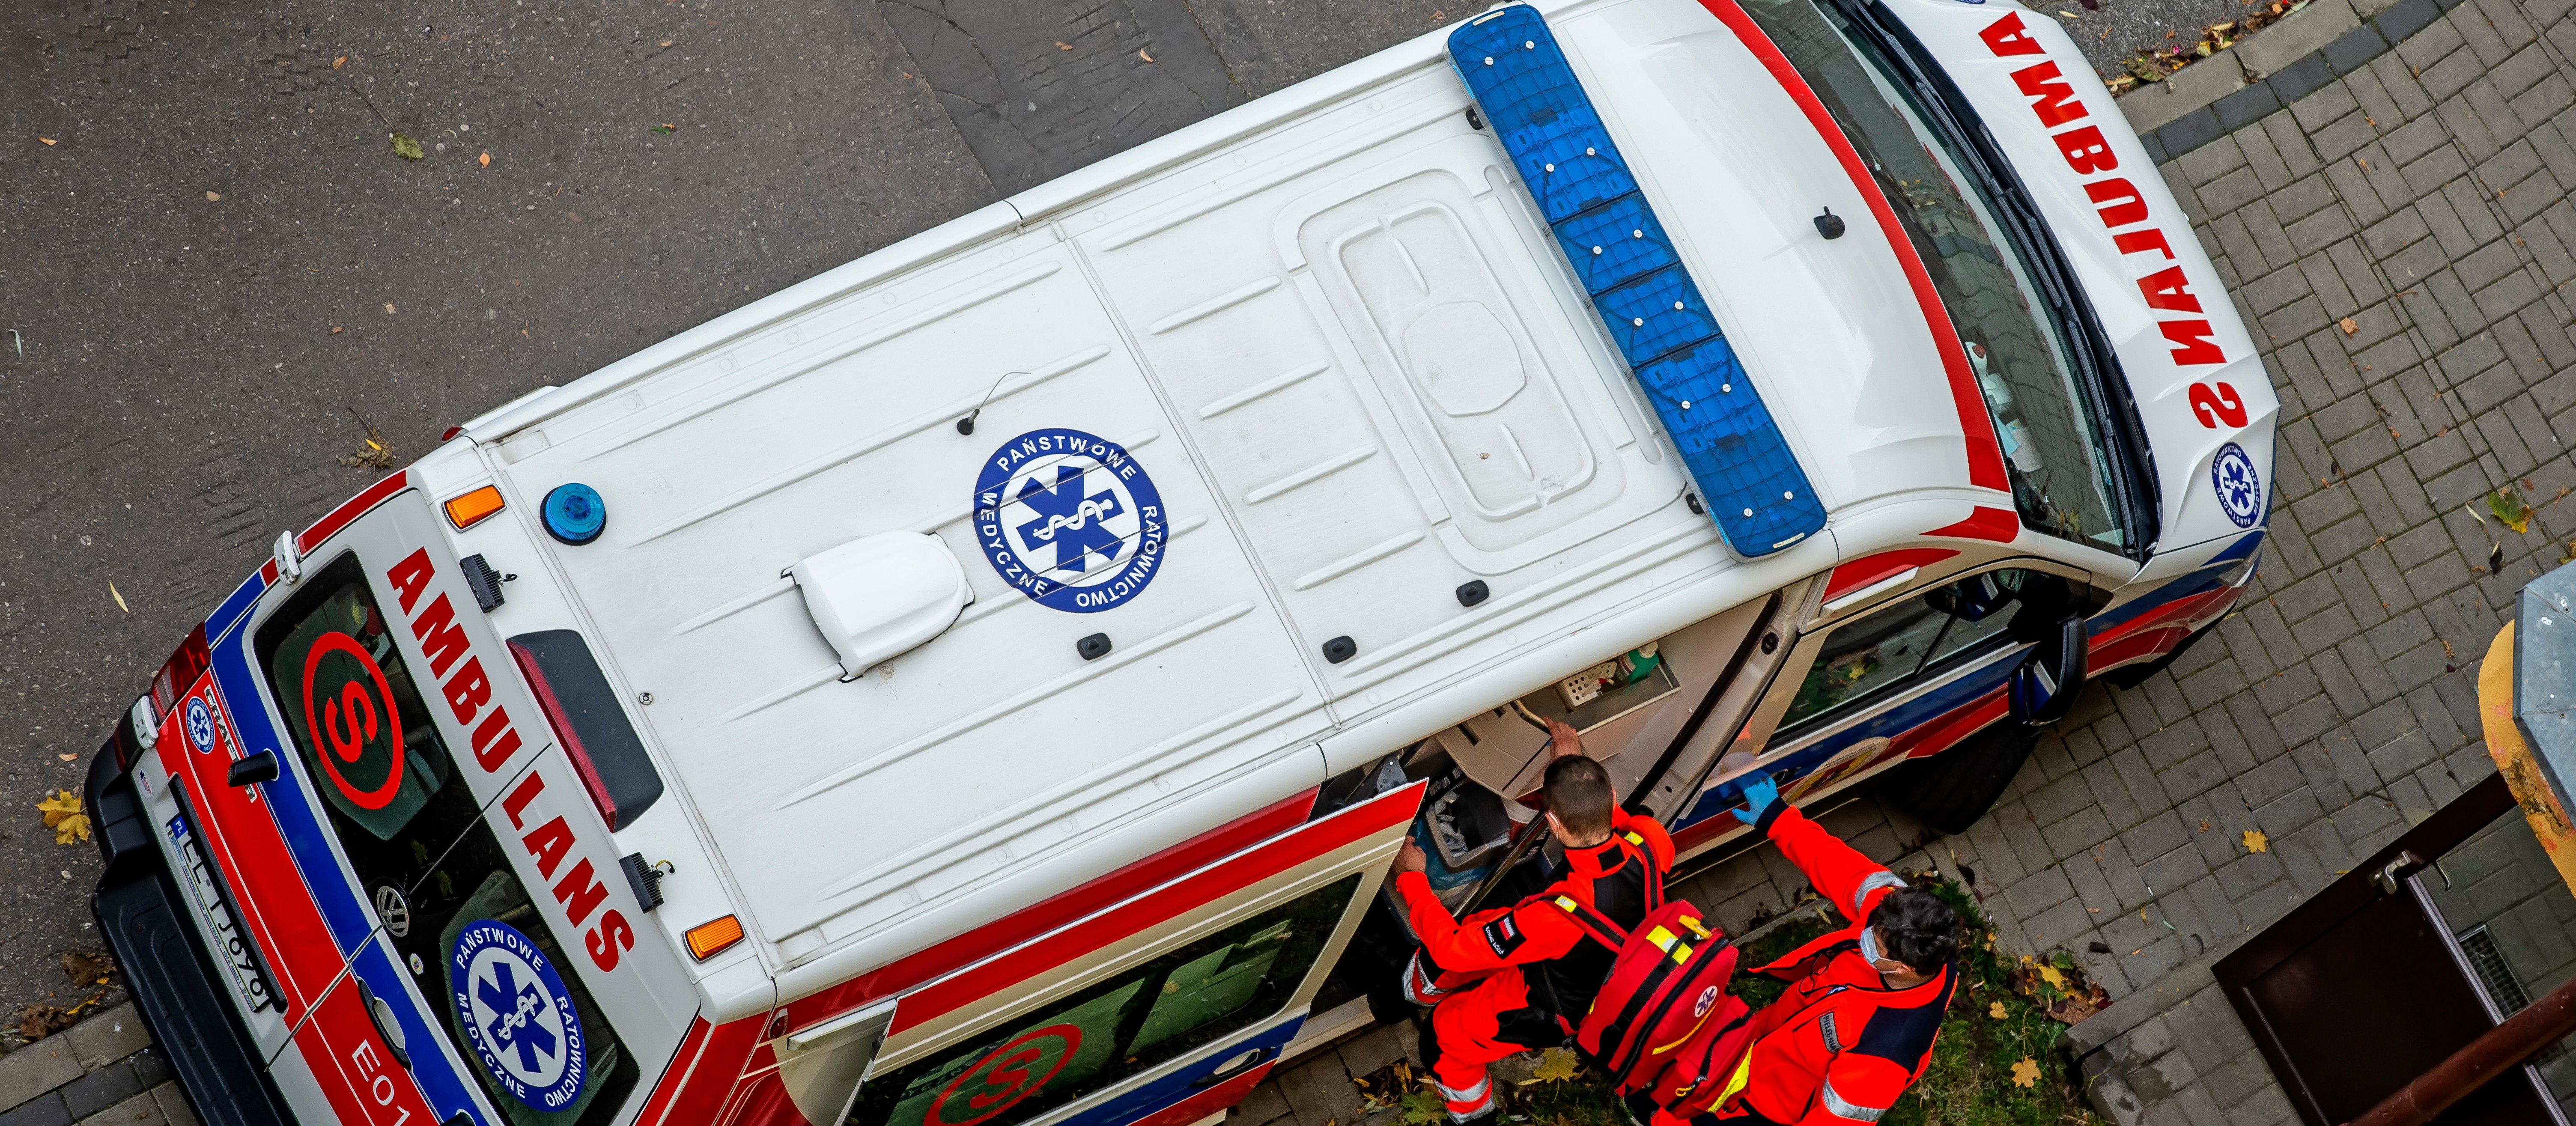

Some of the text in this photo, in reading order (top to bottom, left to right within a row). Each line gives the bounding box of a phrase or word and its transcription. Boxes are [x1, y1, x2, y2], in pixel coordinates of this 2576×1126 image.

[981, 435, 1160, 607] PAŃSTWOWE RATOWNICTWO MEDYCZNE
[2213, 445, 2259, 526] RATOWNICTWO MEDYCZNE PAŃSTWOWE
[187, 699, 214, 751] PAŃSTWOWE RATOWNICTWO MEDYCZNE
[324, 680, 377, 763] S
[386, 546, 635, 972] AMBULANS
[175, 820, 183, 834] PL
[456, 926, 582, 1107] PAŃSTWOWE RATOWNICTWO MEDYCZNE
[970, 1048, 1041, 1108] S
